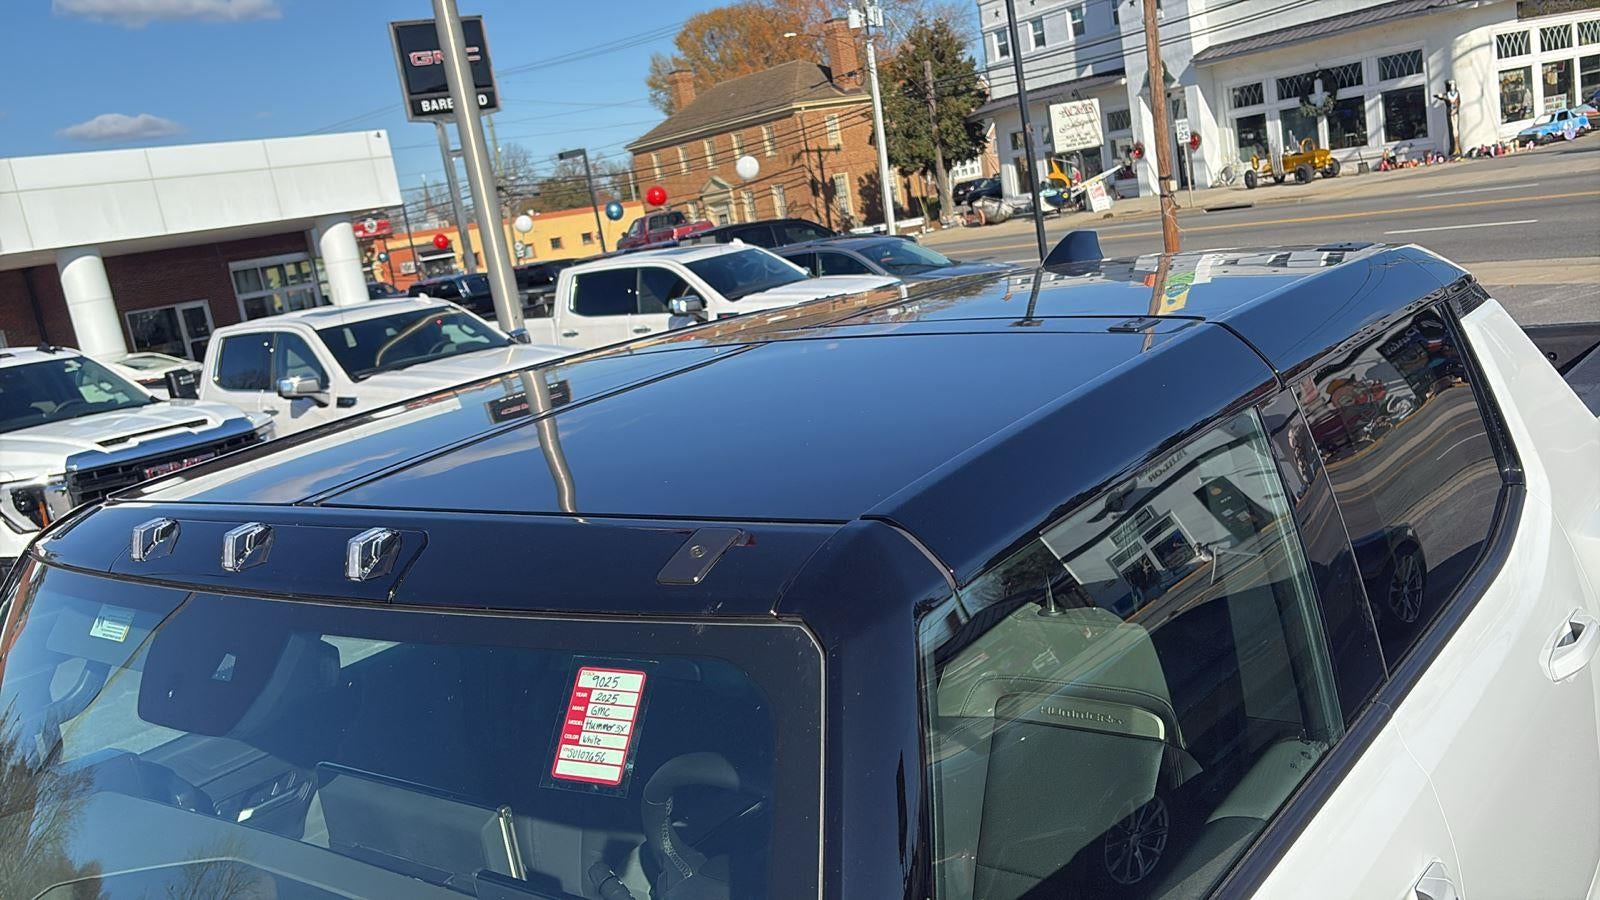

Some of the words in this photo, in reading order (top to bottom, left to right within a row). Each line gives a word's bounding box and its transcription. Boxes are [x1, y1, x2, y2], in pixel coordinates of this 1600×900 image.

[1178, 130, 1190, 141] 25
[592, 675, 620, 688] 9025
[595, 692, 620, 704] 2025
[591, 705, 611, 717] GMC
